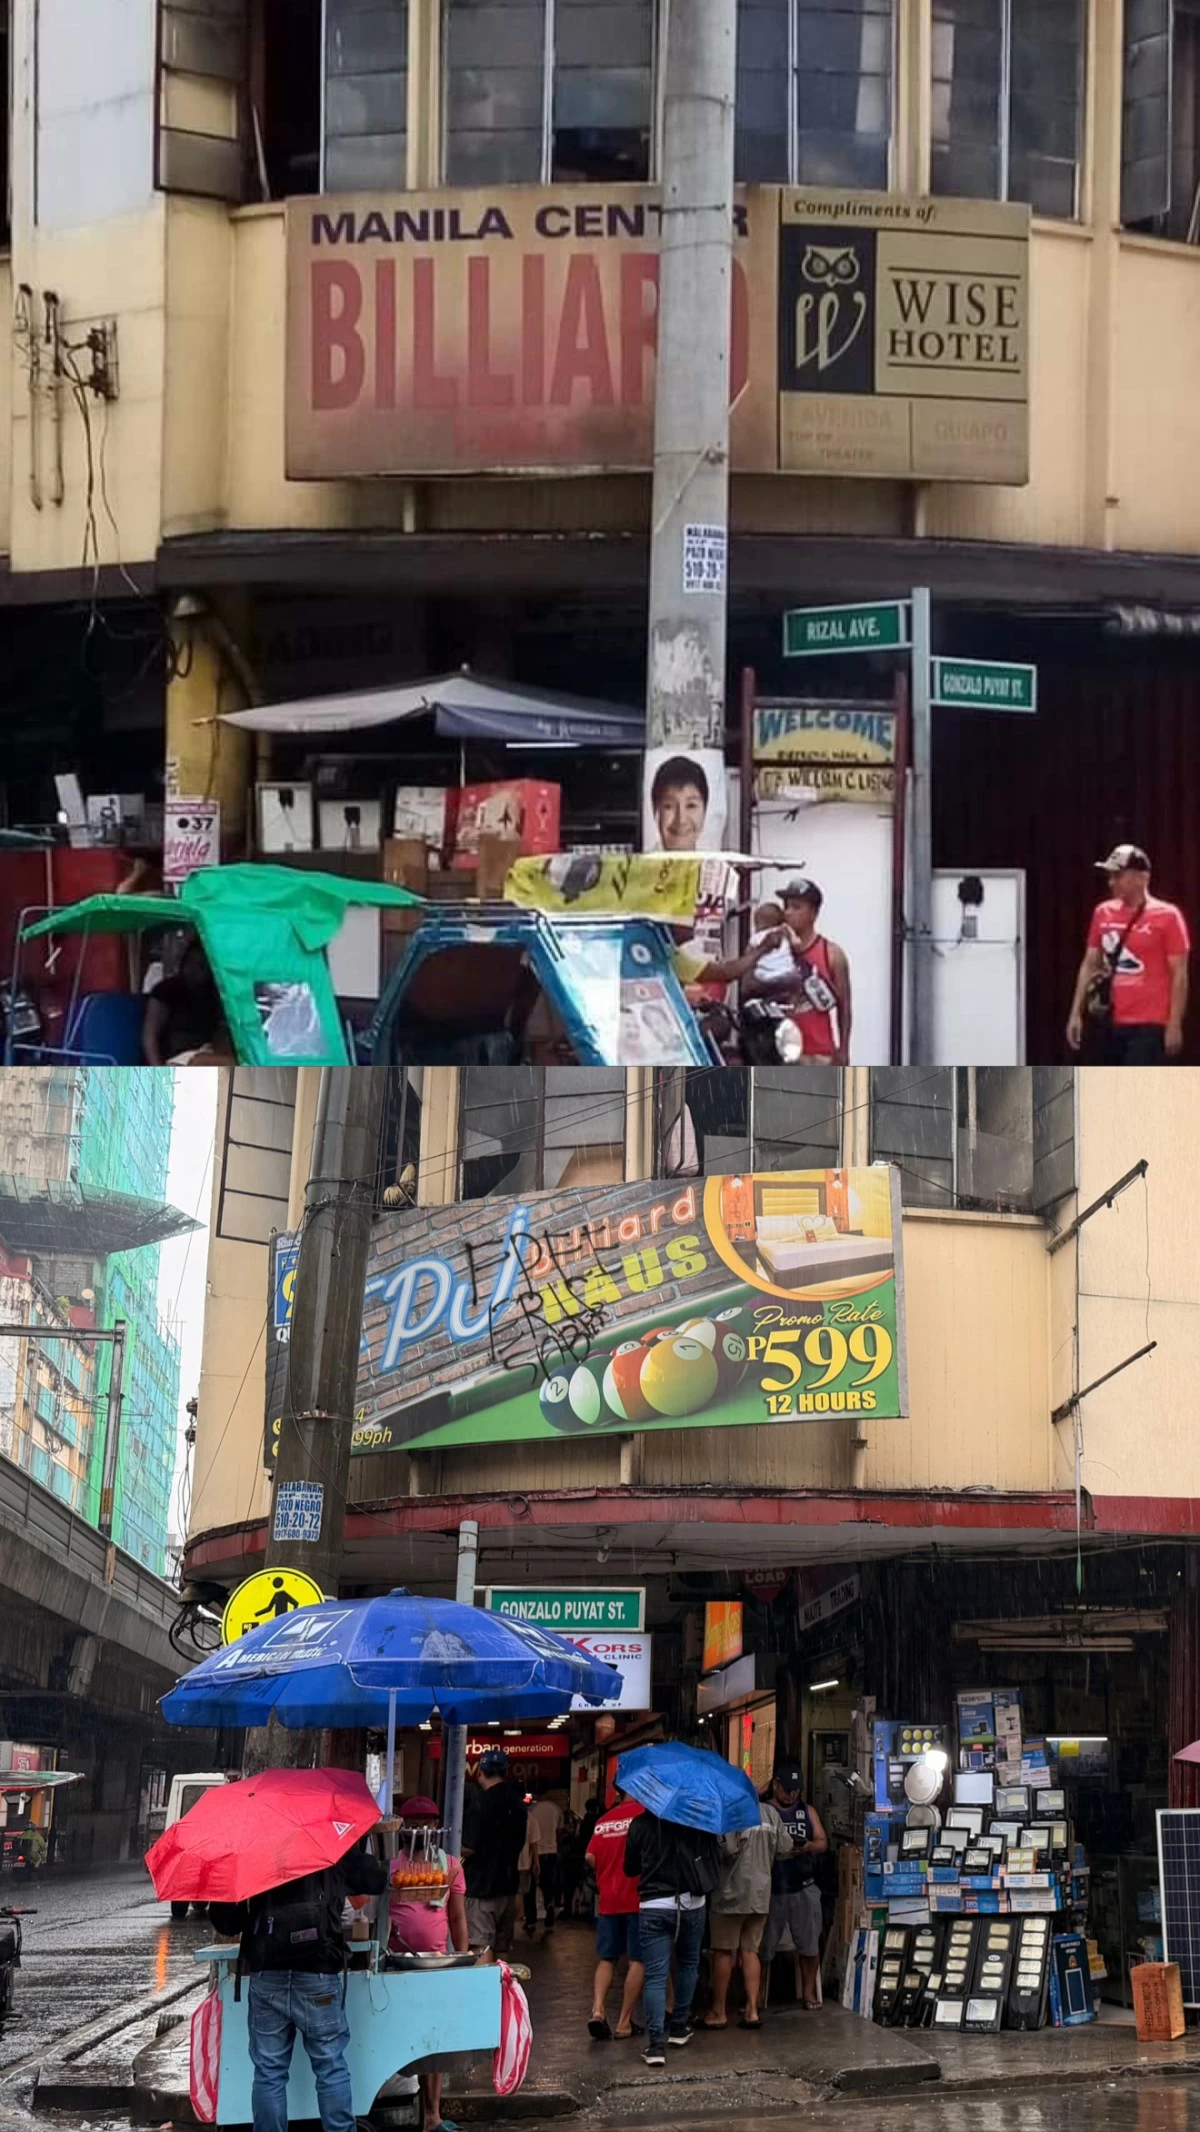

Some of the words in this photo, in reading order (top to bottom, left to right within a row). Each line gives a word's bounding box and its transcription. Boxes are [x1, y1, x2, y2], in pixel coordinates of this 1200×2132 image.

[794, 200, 911, 219] Compliments
[311, 206, 514, 245] MANILA
[892, 278, 1020, 329] WISE
[888, 328, 1019, 364] HOTEL
[807, 620, 846, 642] RIZAL
[849, 618, 881, 640] AVE.
[943, 674, 982, 696] GONZALO
[758, 709, 893, 753] WELCOME
[191, 817, 214, 831] 37
[529, 1186, 697, 1281] Billiard
[538, 1235, 708, 1325] HAUS
[753, 1305, 824, 1334] Promo
[830, 1300, 887, 1324] Rate
[766, 1394, 793, 1415] 12
[798, 1390, 878, 1413] HOURS
[277, 1499, 294, 1512] POZO
[295, 1499, 322, 1513] NEGRO
[275, 1512, 320, 1530] 510-20-72
[744, 1571, 786, 1584] LOAD
[500, 1601, 561, 1620] GONZALO
[564, 1601, 604, 1620] PUYAT
[607, 1601, 626, 1620] ST.
[465, 1738, 501, 1755] rban
[503, 1743, 554, 1756] generation
